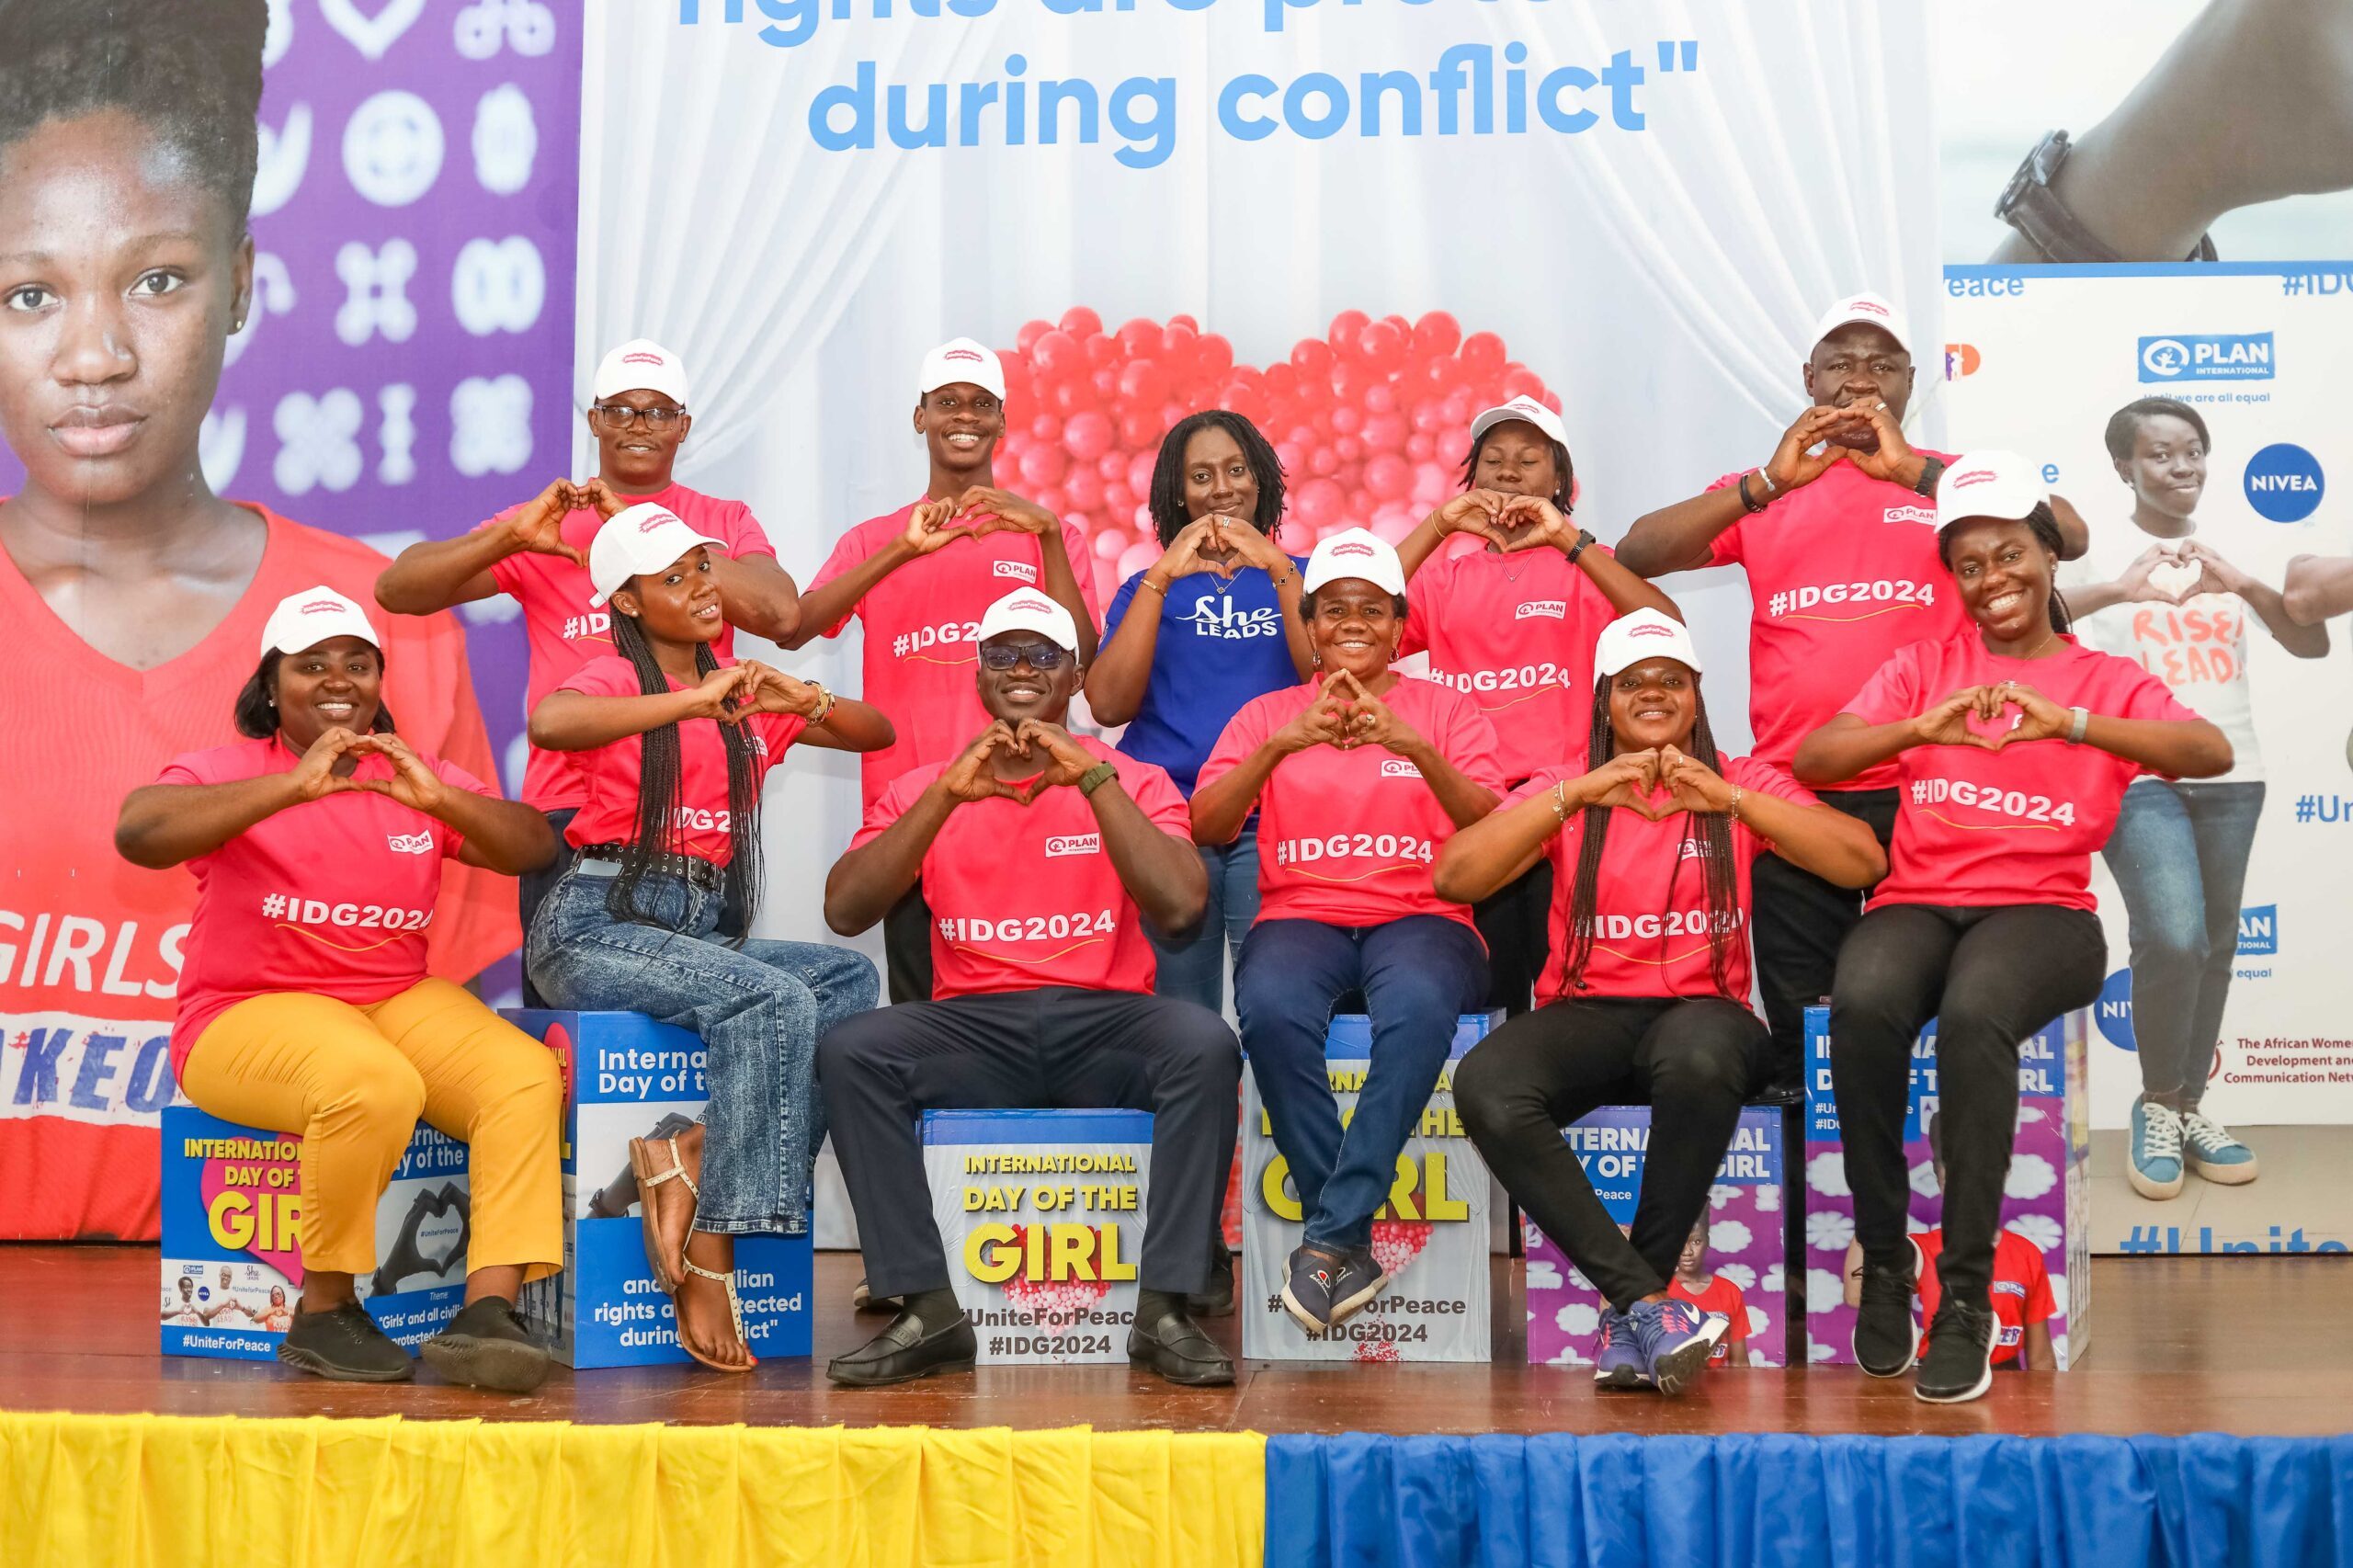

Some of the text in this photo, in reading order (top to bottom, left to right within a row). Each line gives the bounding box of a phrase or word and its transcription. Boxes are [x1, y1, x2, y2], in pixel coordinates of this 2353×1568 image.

[808, 40, 1699, 169] during conflict"
[2195, 343, 2268, 365] PLAN
[2195, 394, 2217, 403] are
[2218, 392, 2233, 403] all
[2235, 392, 2270, 404] equal
[2251, 474, 2318, 492] NIVEA
[1906, 508, 1934, 520] PLAN
[1013, 564, 1036, 577] PLAN
[1535, 603, 1563, 613] PLAN
[1768, 580, 1935, 618] #IDG2024
[1176, 595, 1282, 628] She
[1196, 621, 1278, 640] LEADS
[1429, 662, 1571, 694] #IDG2024
[1911, 778, 2075, 826] #IDG2024
[1068, 837, 1097, 847] PLAN
[1277, 834, 1434, 866] #IDG2024
[261, 892, 434, 930] #IDG2024
[938, 909, 1116, 942] #IDG2024
[2236, 968, 2272, 981] equal
[2237, 1038, 2353, 1050] The African Wome
[2246, 1055, 2333, 1068] Development
[598, 1072, 654, 1099] Day
[660, 1069, 688, 1092] of
[2223, 1072, 2325, 1084] Communication
[416, 1146, 434, 1168] of
[437, 1146, 464, 1166] the
[964, 1153, 1137, 1175] INTERNATIONAL
[1597, 1154, 1636, 1178] OF
[224, 1165, 294, 1187] DAY OF
[964, 1185, 1137, 1212] DAY OF THE
[963, 1222, 1137, 1284] GIRL
[408, 1310, 426, 1325] and
[427, 1308, 439, 1322] all
[594, 1301, 655, 1326] rights
[183, 1335, 271, 1352] #UniteForPeace
[989, 1335, 1111, 1356] #IDG2024
